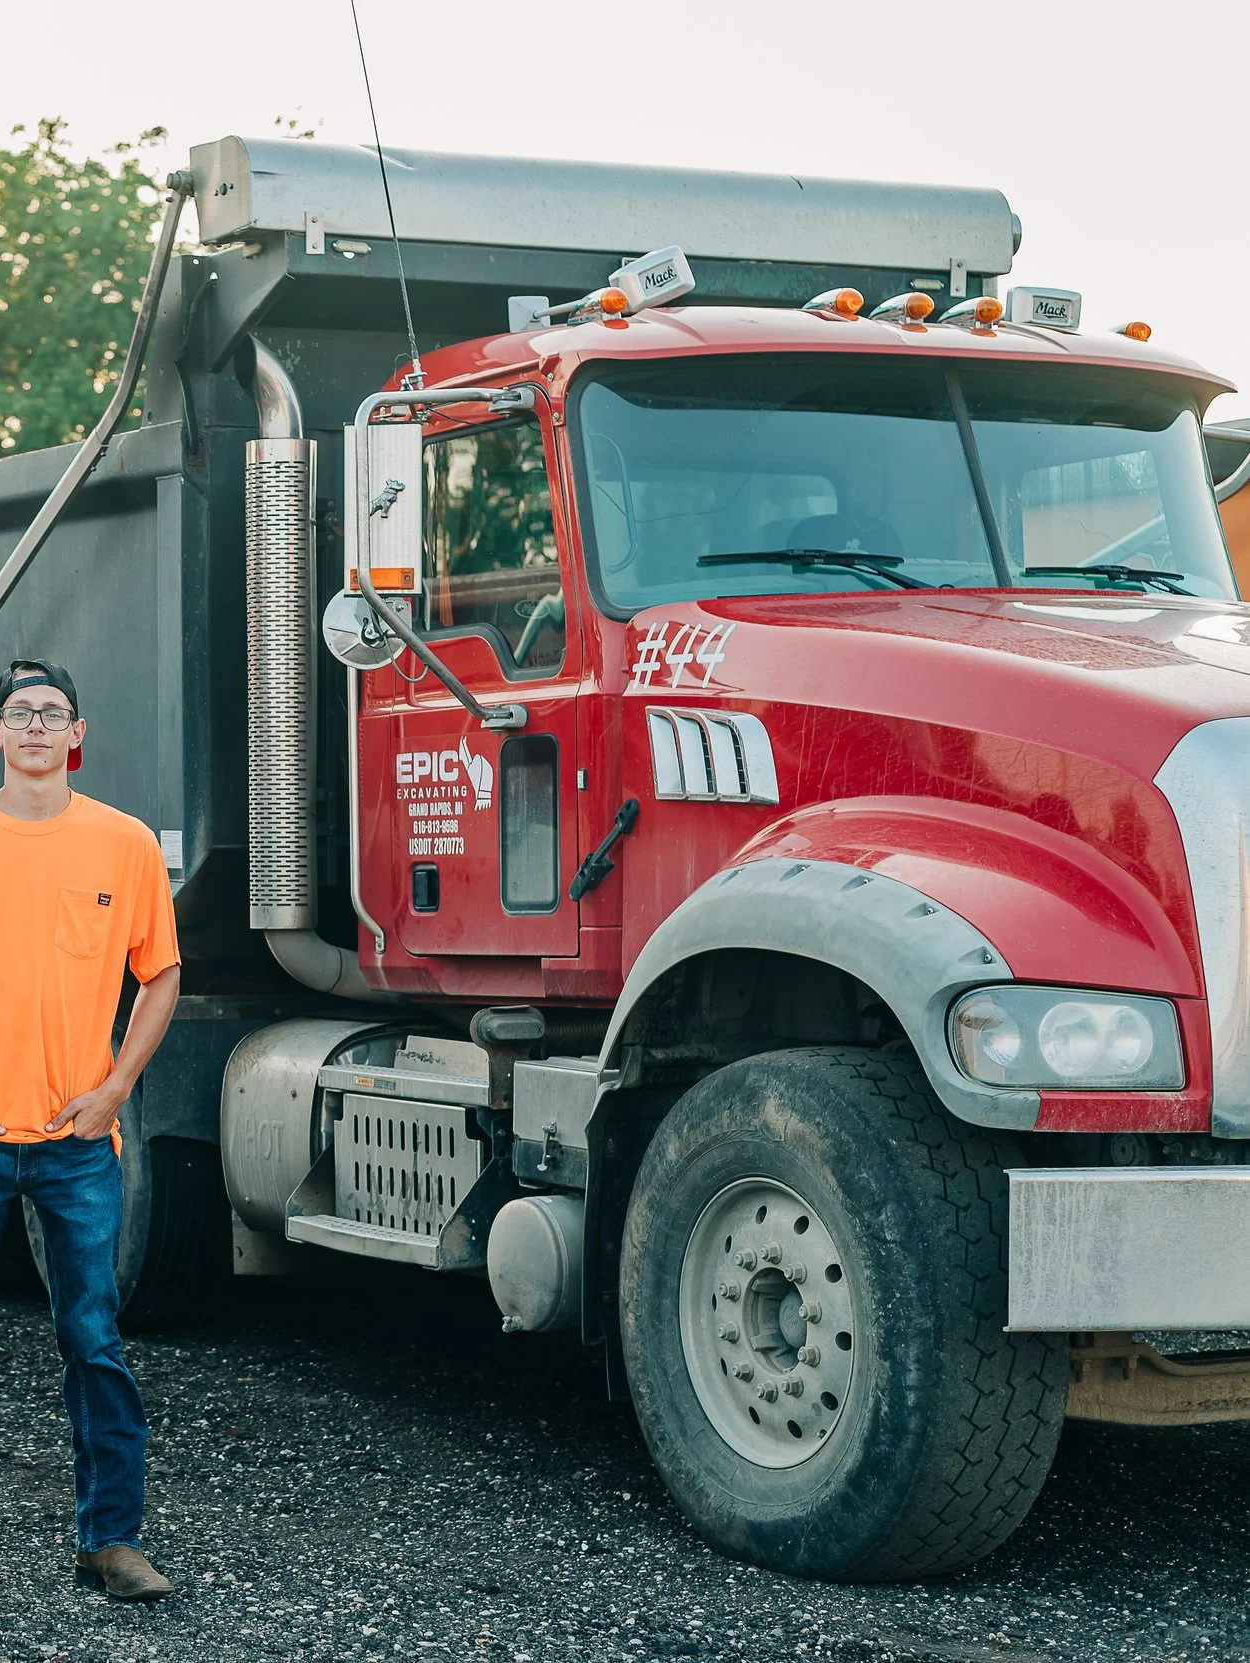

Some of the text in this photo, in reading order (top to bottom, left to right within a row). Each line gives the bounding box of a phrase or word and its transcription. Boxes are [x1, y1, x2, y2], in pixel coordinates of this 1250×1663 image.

[645, 266, 677, 289] Mack
[1035, 301, 1068, 319] Mack
[632, 622, 736, 689] #44
[396, 750, 459, 784] EPIC
[396, 786, 467, 799] EXCAVATING
[409, 803, 429, 816] GRAND
[409, 836, 464, 855] USDOT 2870773
[245, 1118, 285, 1162] HOT
